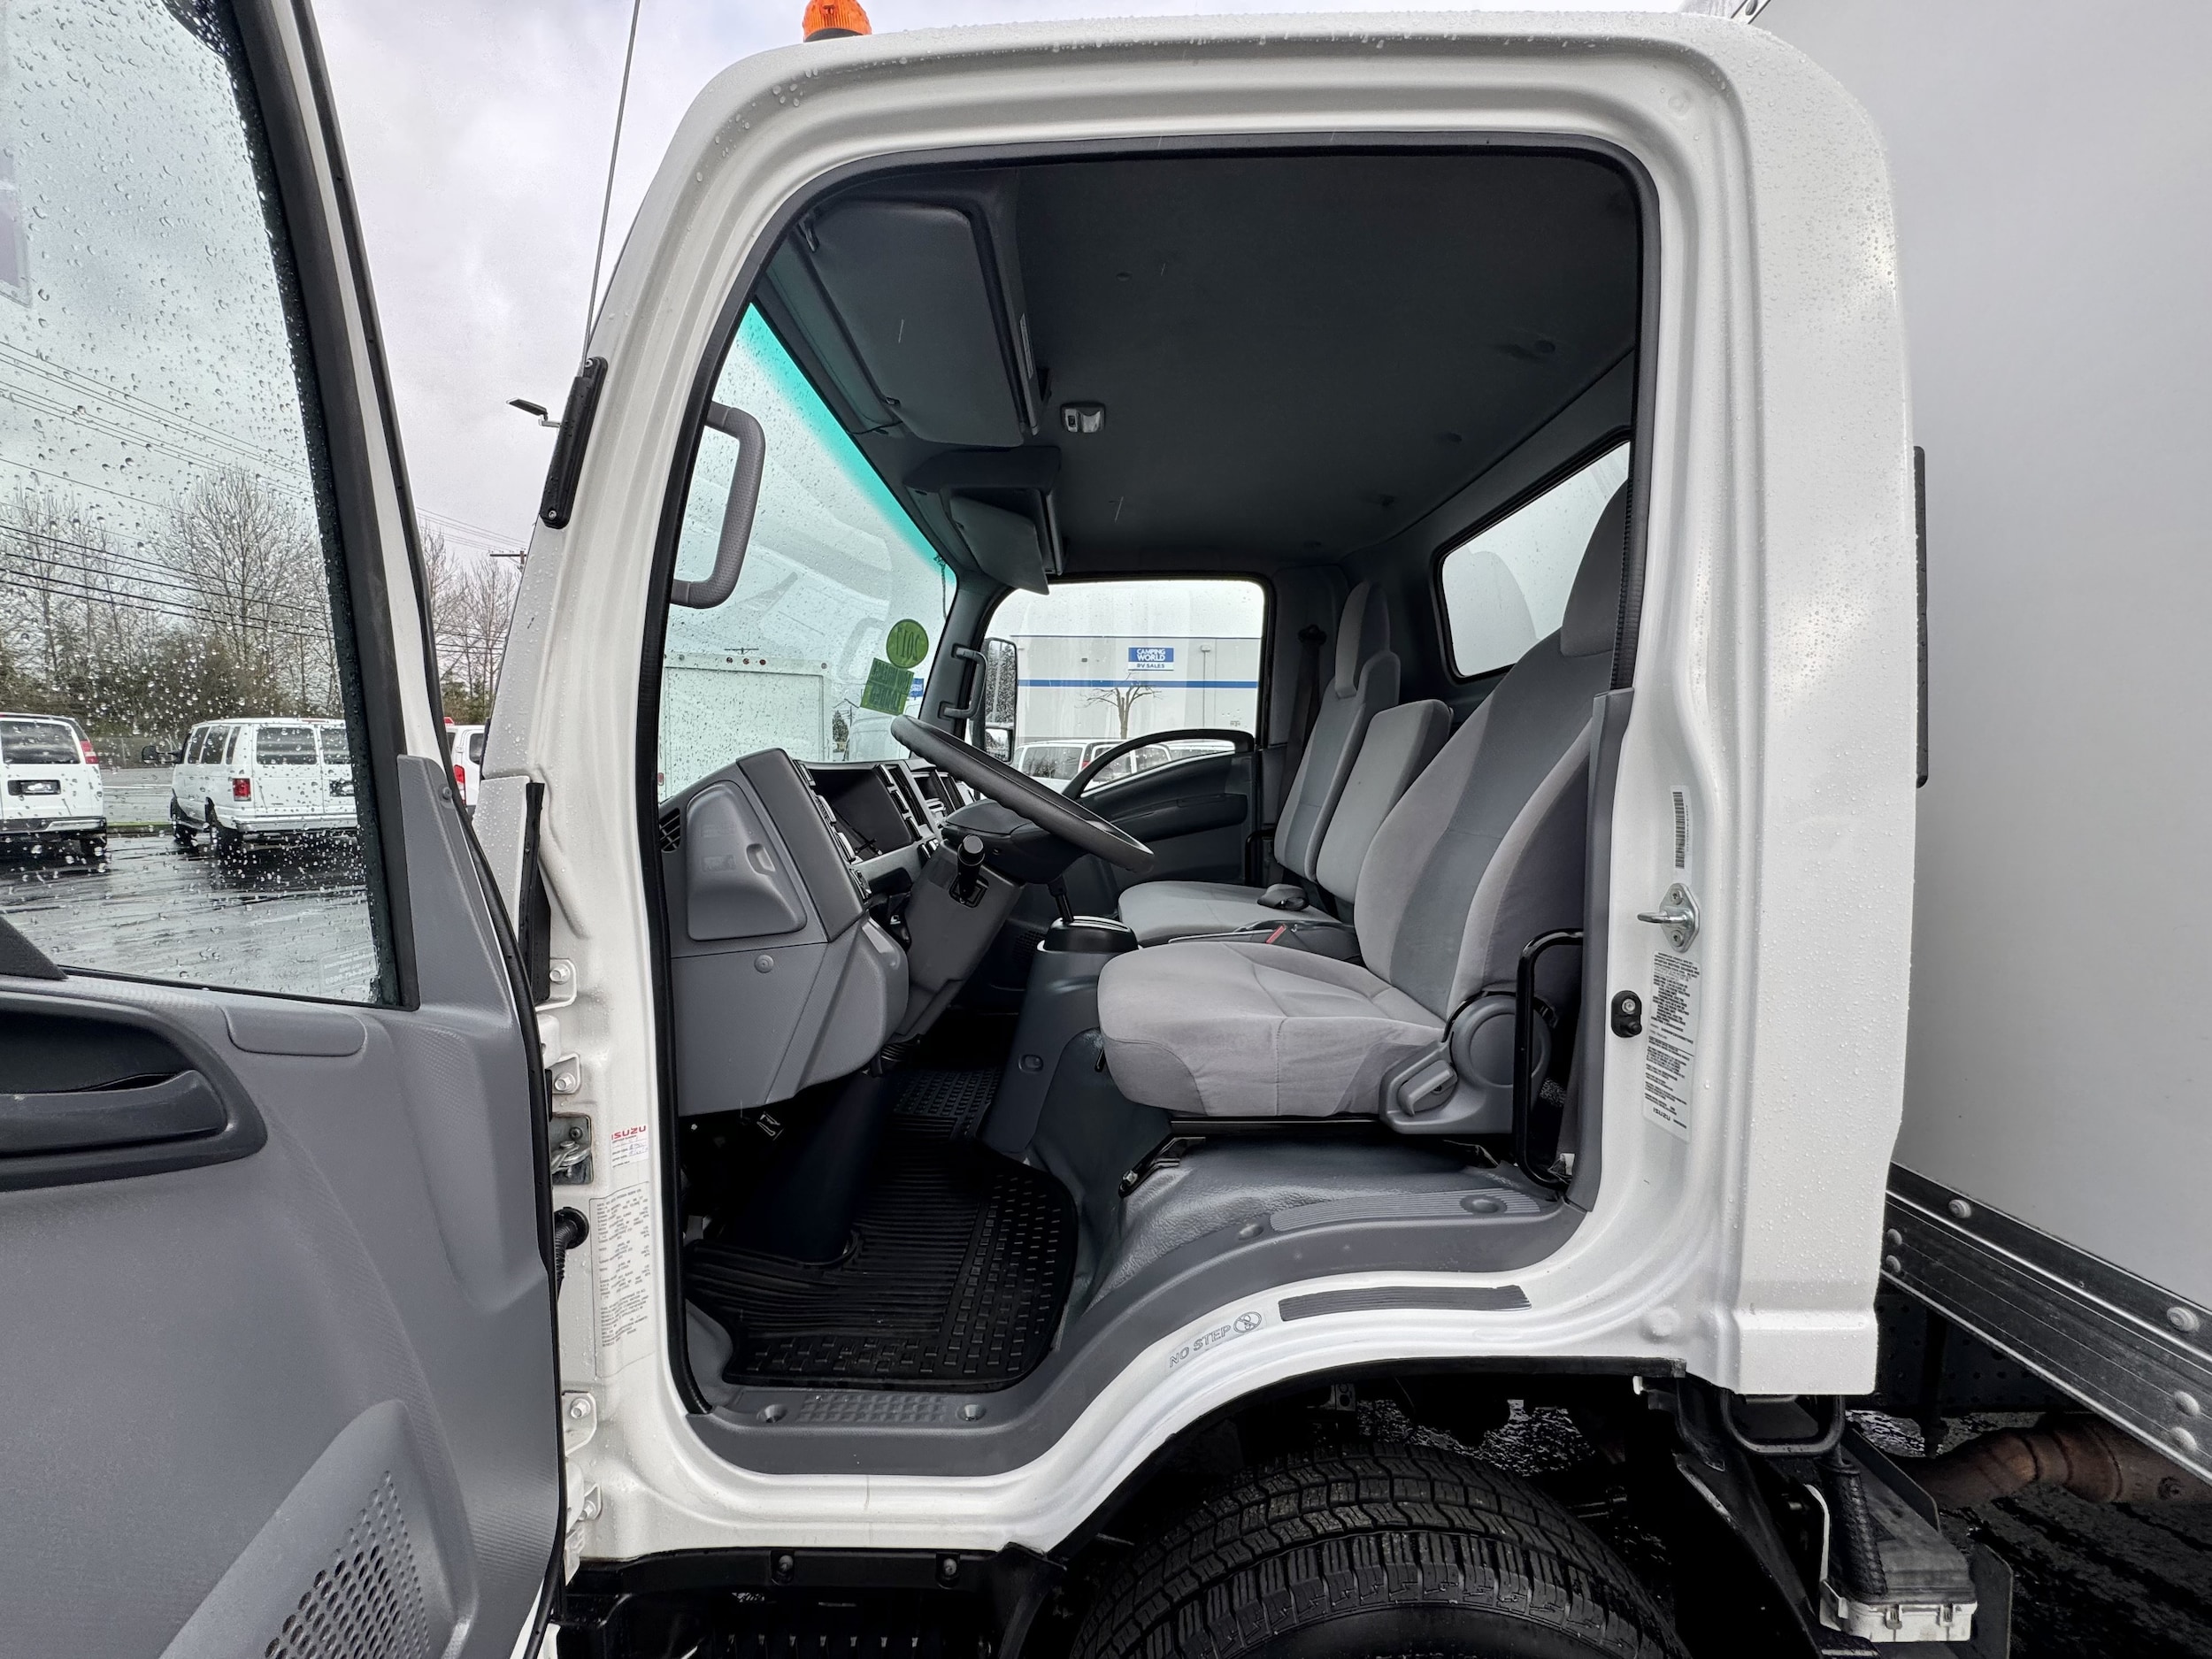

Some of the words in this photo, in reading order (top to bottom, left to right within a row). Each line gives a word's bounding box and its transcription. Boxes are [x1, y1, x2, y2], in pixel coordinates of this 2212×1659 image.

[1653, 1107, 1671, 1121] ISUZU
[611, 1125, 647, 1141] ISUZU
[1169, 1346, 1190, 1369] NO
[1193, 1325, 1232, 1352] STEP
